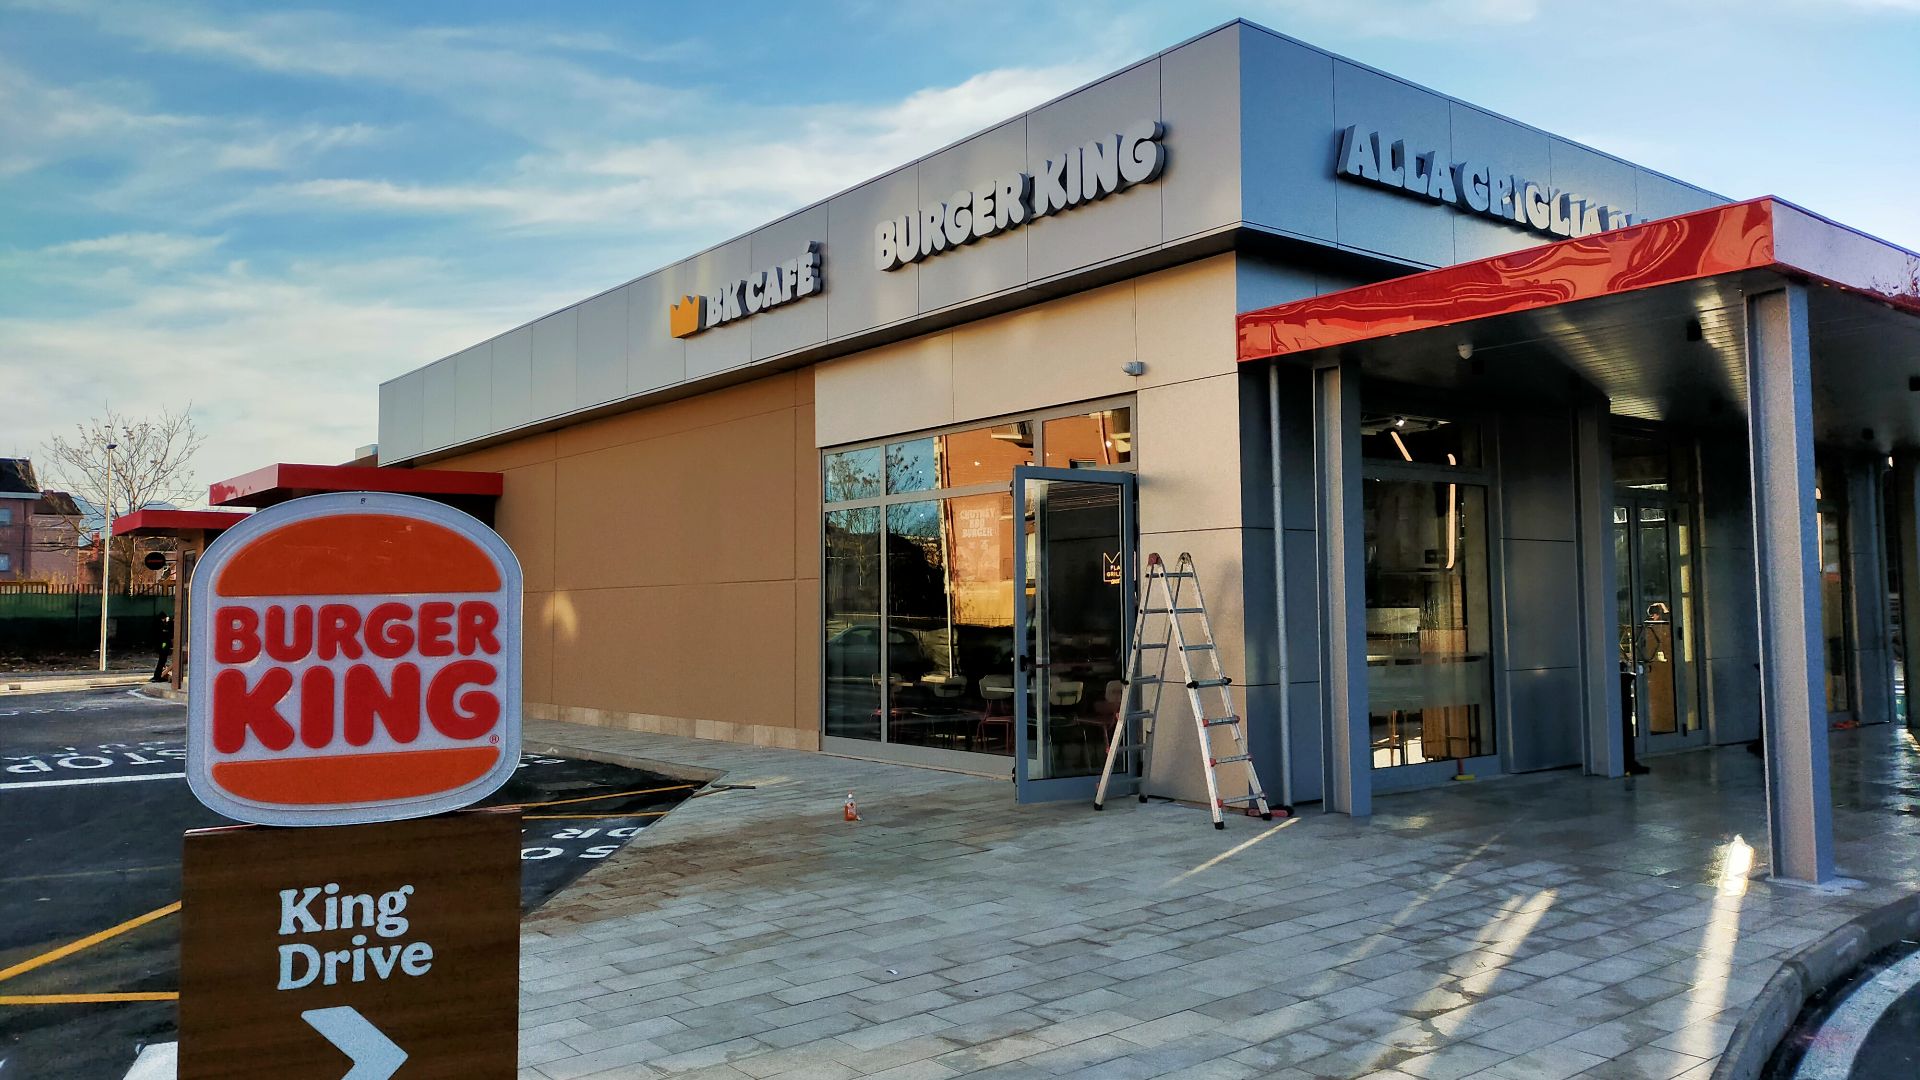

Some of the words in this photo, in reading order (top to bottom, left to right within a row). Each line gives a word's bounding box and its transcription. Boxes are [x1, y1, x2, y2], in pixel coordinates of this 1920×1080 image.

[875, 172, 1029, 272] BURGER
[1030, 120, 1164, 219] KING
[1342, 123, 1458, 204] ALLA
[706, 279, 743, 327] BK
[745, 240, 821, 314] CAFÉ
[214, 600, 501, 664] BURGER
[212, 659, 500, 754] KING
[278, 882, 415, 938] King
[277, 933, 434, 991] Drive
